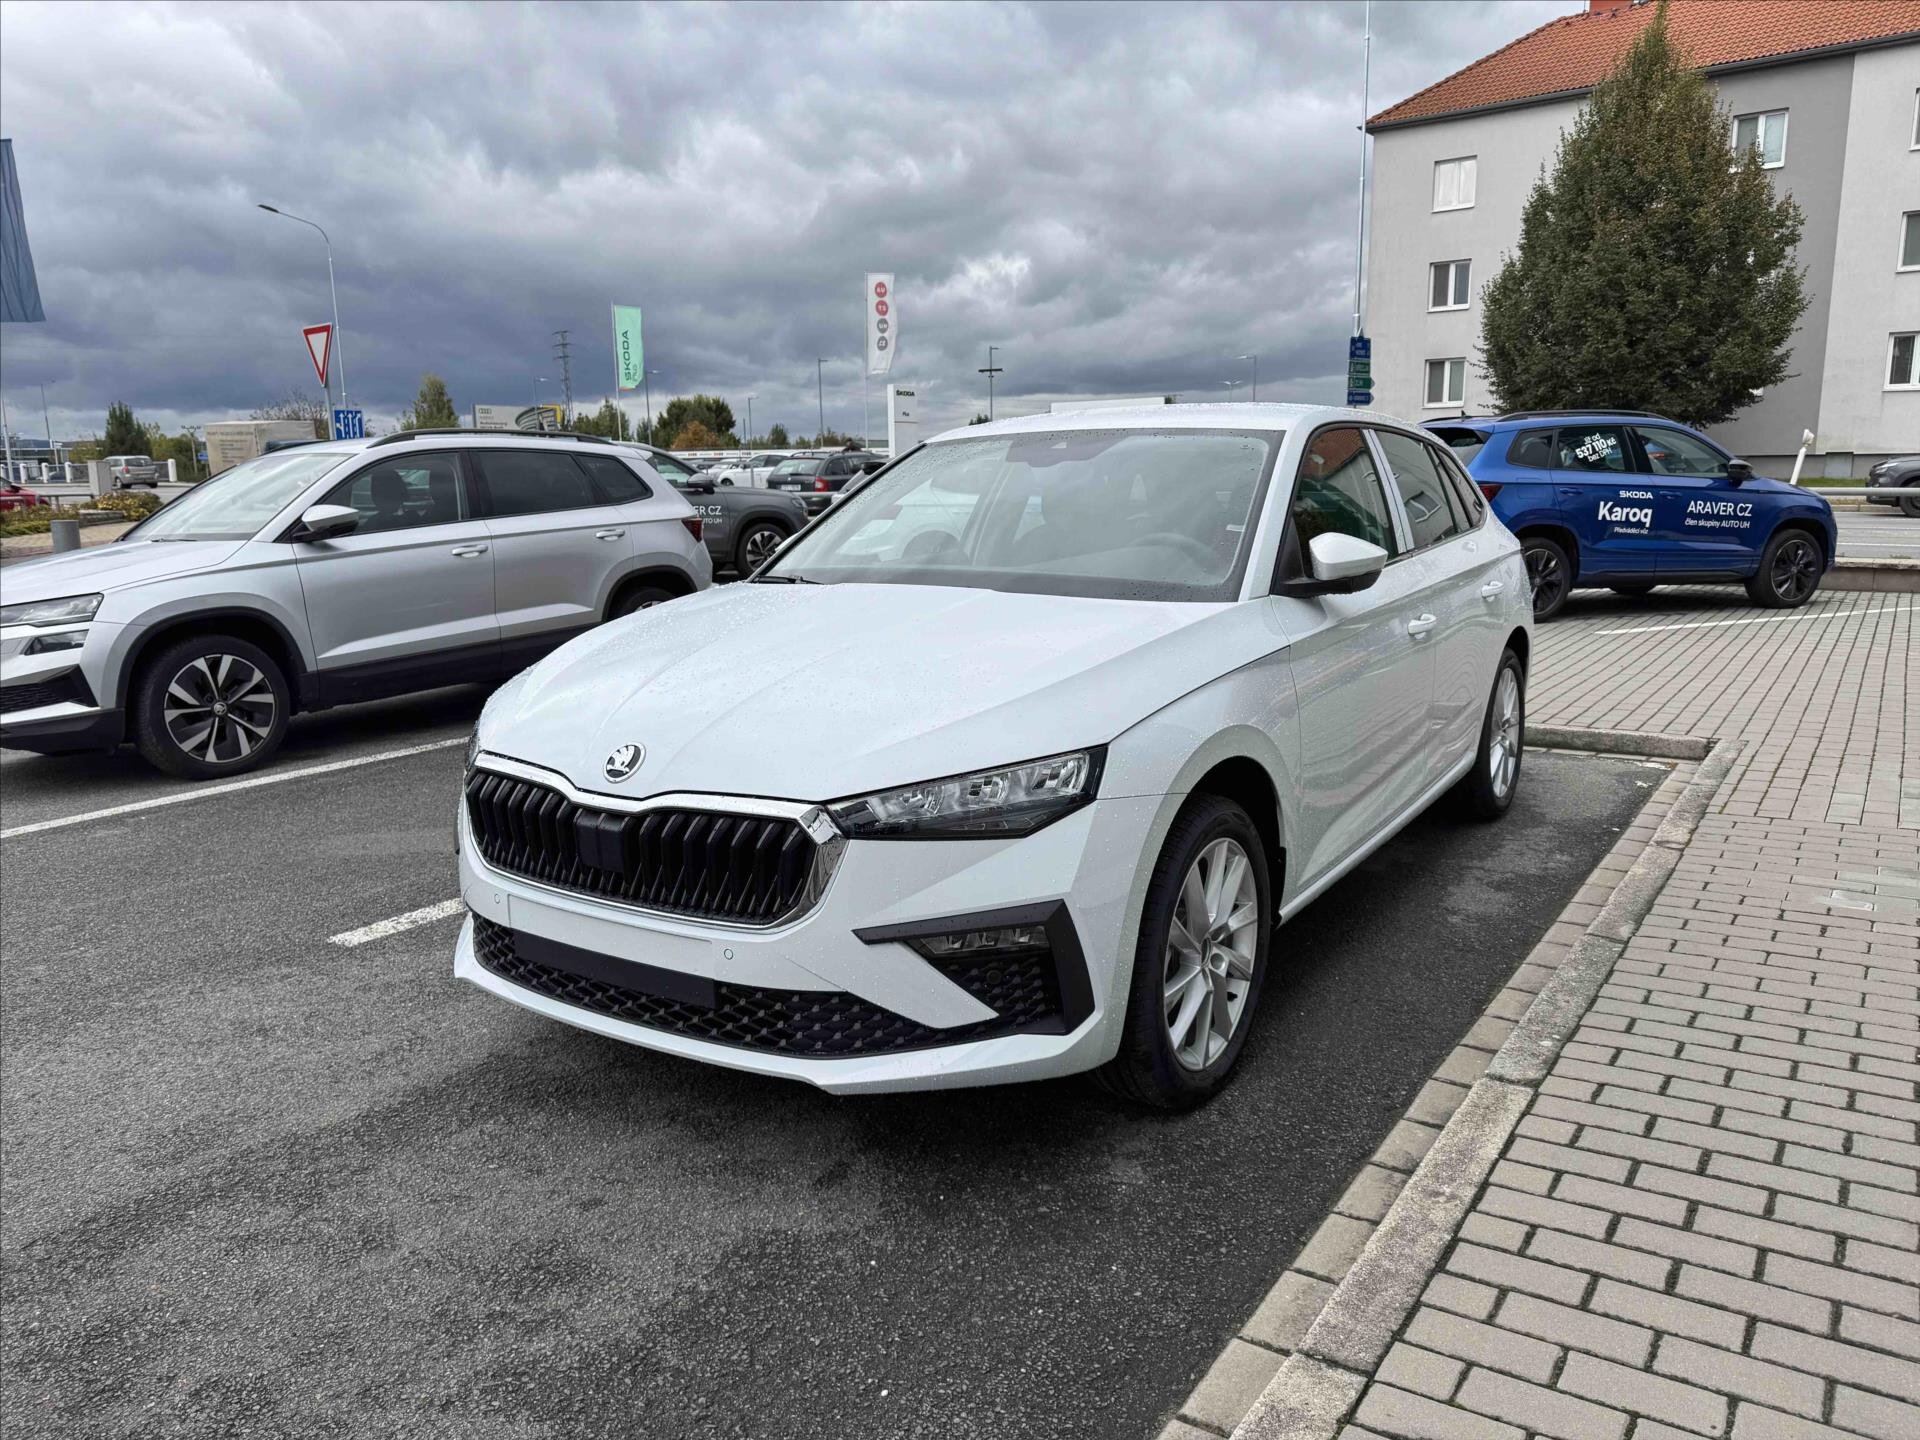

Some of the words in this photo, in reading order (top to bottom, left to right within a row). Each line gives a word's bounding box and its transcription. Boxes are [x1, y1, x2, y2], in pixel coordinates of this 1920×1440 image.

[1575, 444, 1593, 459] 537
[1592, 438, 1608, 452] 110
[1599, 447, 1613, 458] DPH
[707, 505, 722, 516] CZ
[1598, 500, 1653, 528] Karoq
[1686, 500, 1735, 516] ARAVER
[1736, 503, 1753, 517] CZ
[1721, 520, 1740, 528] AUTO
[1740, 520, 1751, 529] UH
